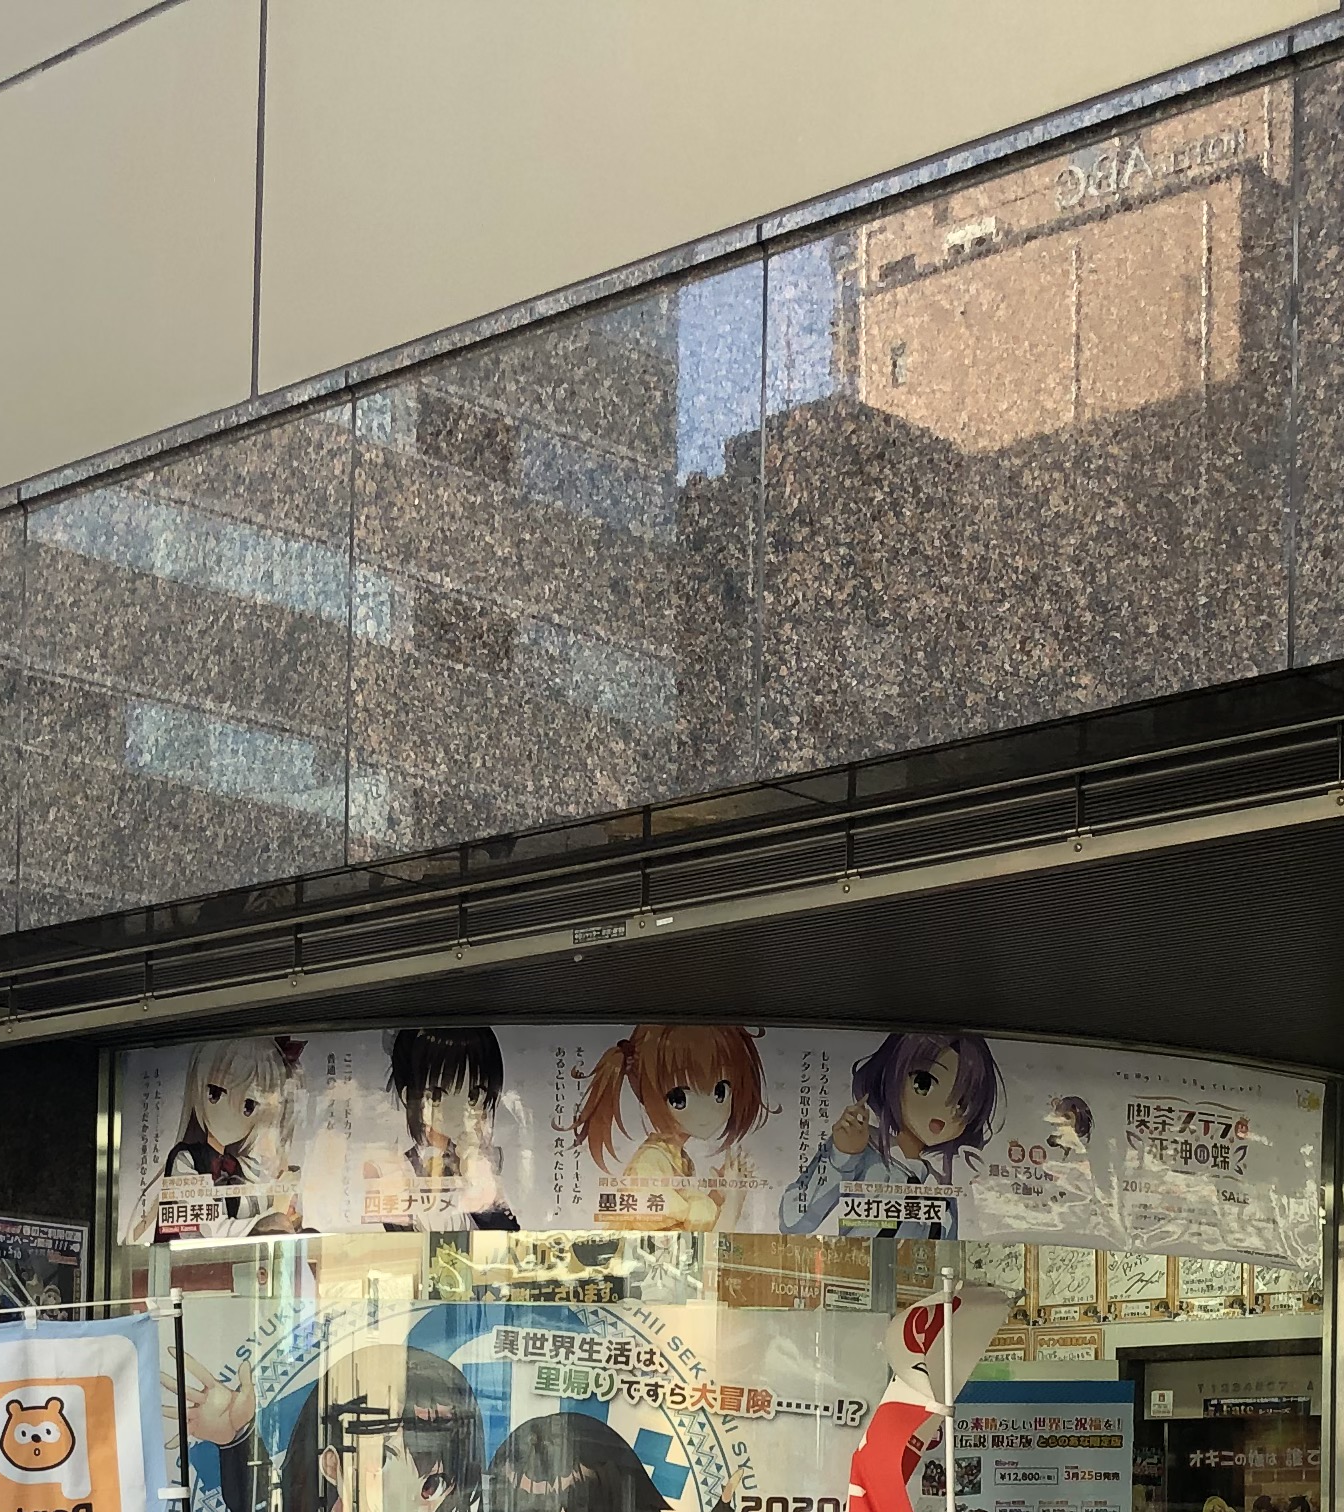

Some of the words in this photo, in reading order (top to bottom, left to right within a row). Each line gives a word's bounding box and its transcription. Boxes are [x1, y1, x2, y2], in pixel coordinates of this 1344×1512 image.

[598, 1193, 638, 1212] 墨染
[647, 1193, 666, 1212] 希
[844, 1199, 942, 1221] 火打谷愛衣
[161, 1202, 220, 1225] 明月栞那
[770, 1281, 798, 1295] FLOOR
[799, 1285, 821, 1298] MAP
[494, 1325, 669, 1374] 異世界生活は、
[1222, 1403, 1255, 1416] Fate
[957, 1416, 1122, 1432] の素晴らしい世界に祝福を!
[991, 1434, 1034, 1450] 限定版
[1063, 1470, 1121, 1481] 3月25日発売
